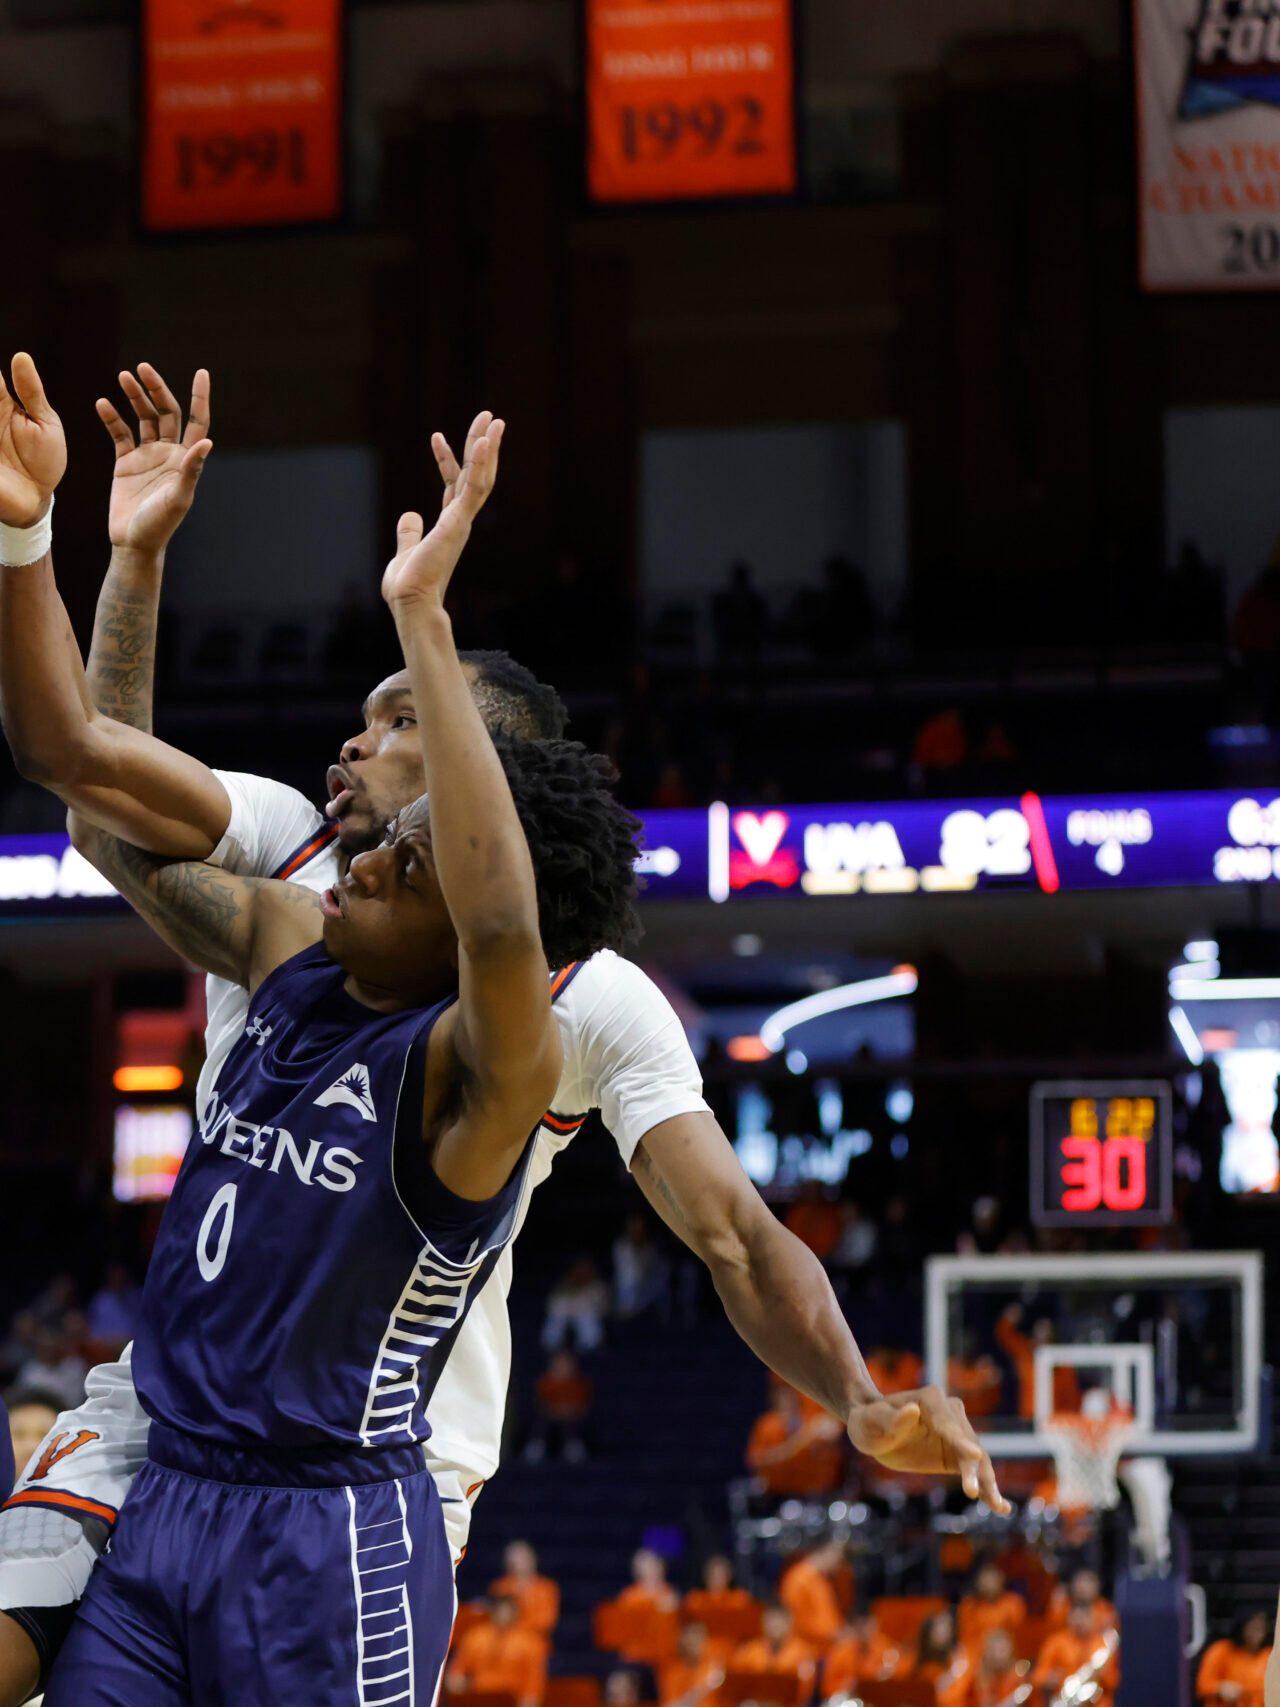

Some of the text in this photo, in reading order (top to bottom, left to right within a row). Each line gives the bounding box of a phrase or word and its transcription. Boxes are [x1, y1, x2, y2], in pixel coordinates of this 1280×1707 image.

[174, 125, 309, 192] 1991
[620, 95, 766, 162] 1992
[1148, 178, 1280, 216] CHAM
[199, 1091, 365, 1193] QUEENS
[1060, 1135, 1147, 1212] 30
[196, 1182, 238, 1282] 0
